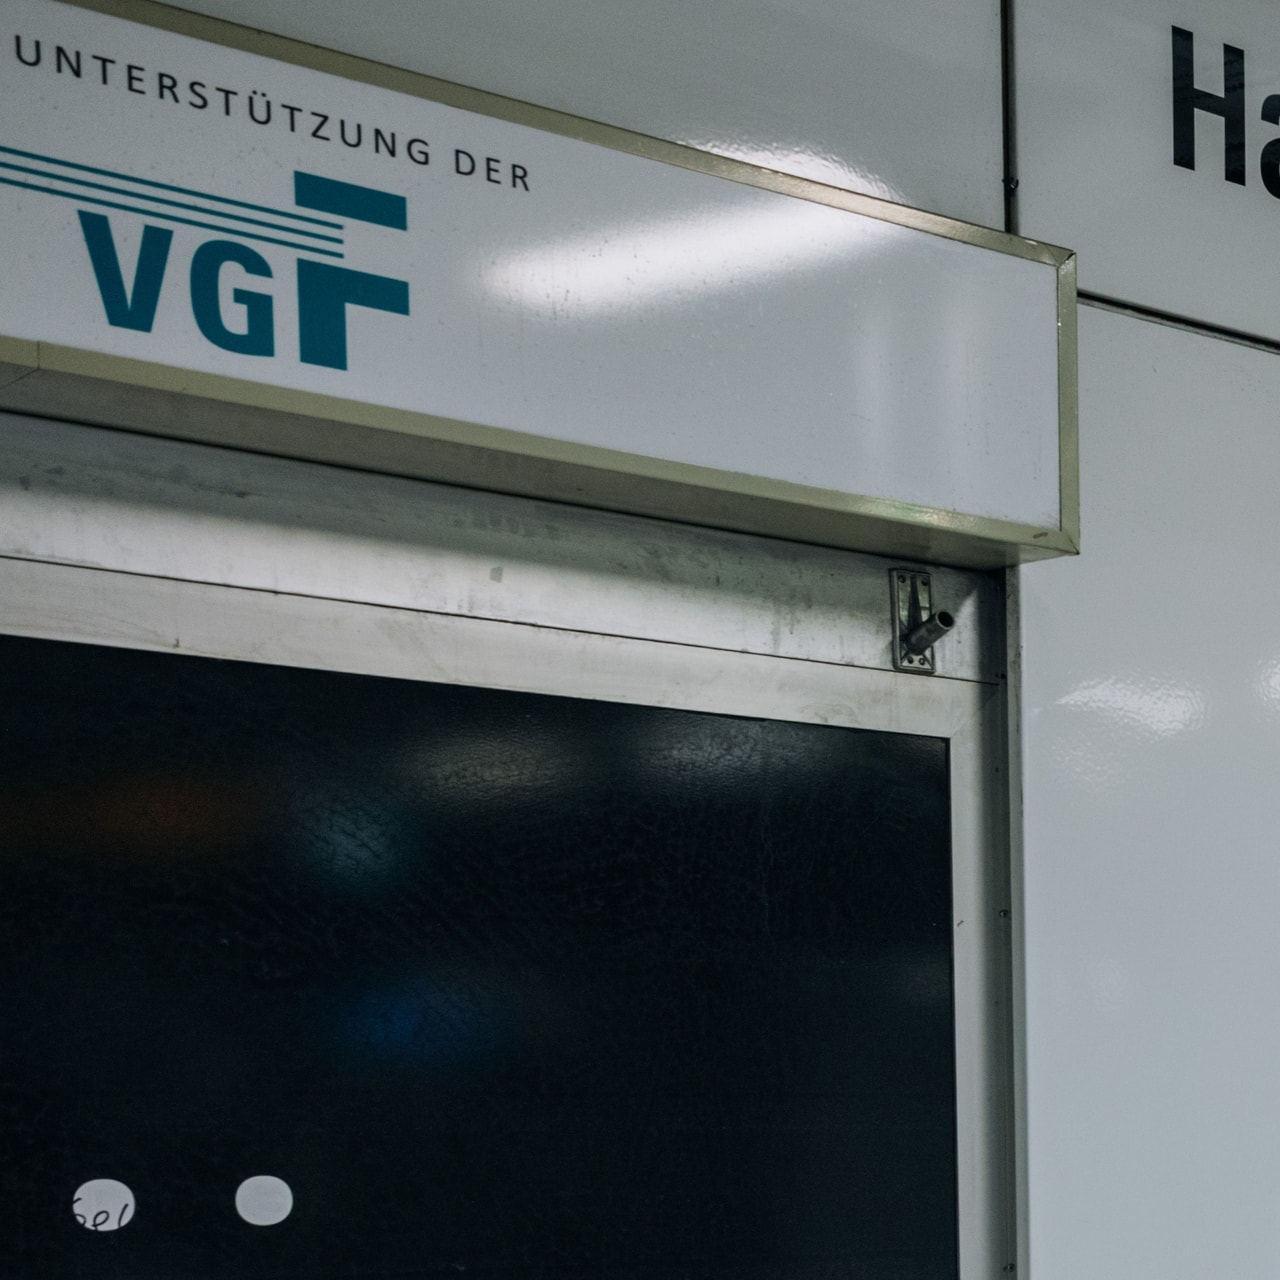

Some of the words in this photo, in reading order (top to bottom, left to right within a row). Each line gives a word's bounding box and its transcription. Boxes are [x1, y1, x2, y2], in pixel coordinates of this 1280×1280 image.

[15, 34, 430, 166] UNTERSTÜTZUNG
[454, 148, 531, 191] DER
[77, 170, 410, 371] VGF
